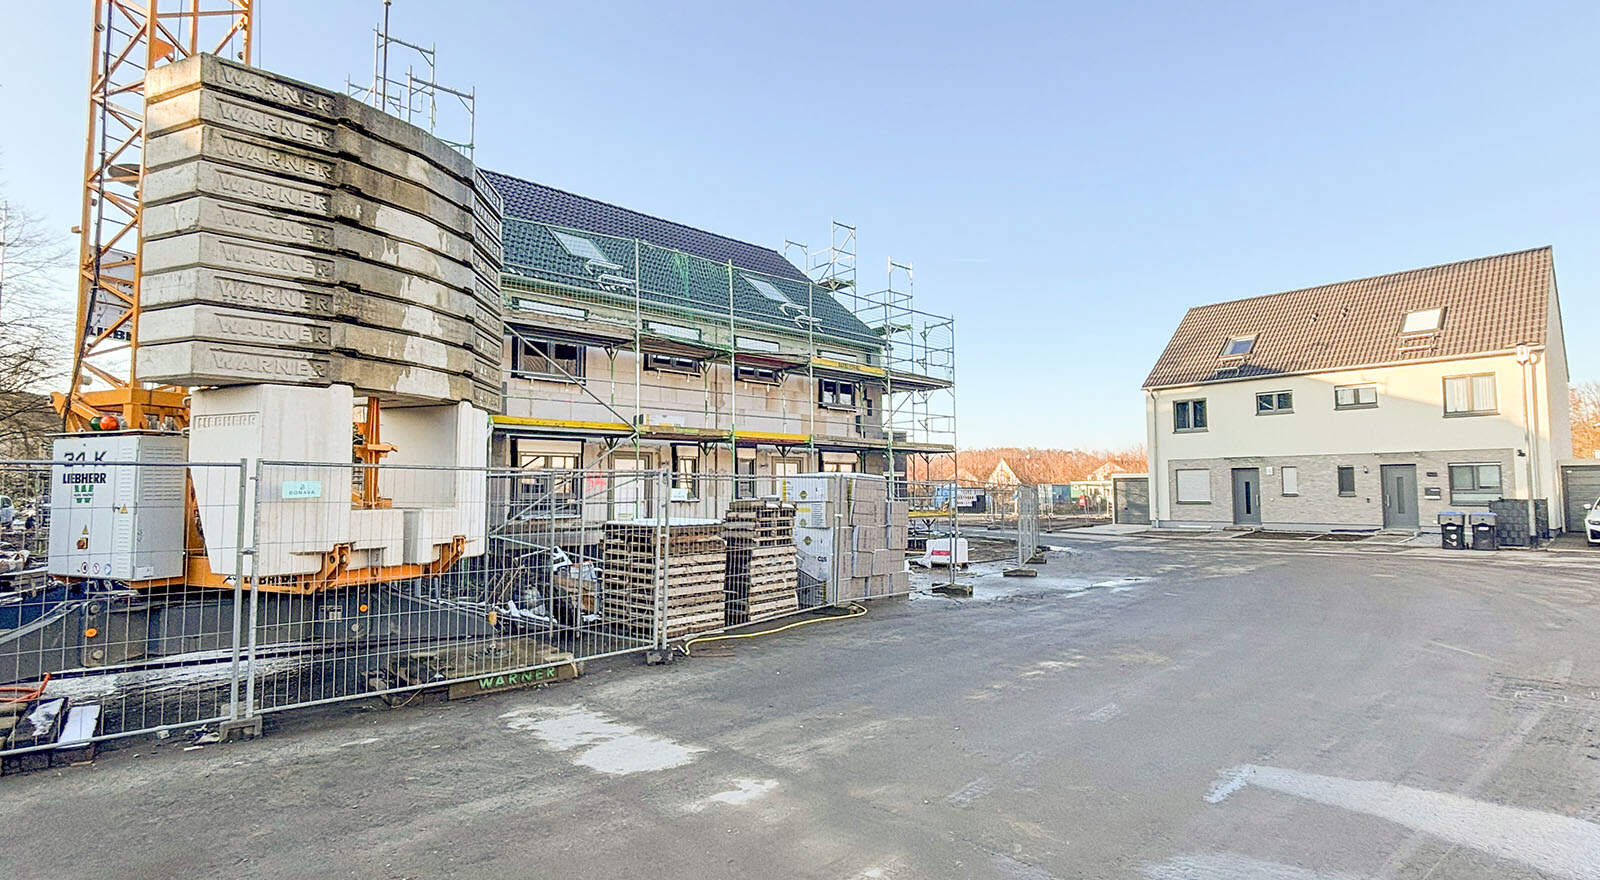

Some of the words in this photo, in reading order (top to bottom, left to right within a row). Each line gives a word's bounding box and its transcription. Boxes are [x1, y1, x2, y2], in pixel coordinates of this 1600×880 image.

[220, 64, 333, 113] WARNER
[218, 102, 331, 147] WARNER
[224, 139, 332, 178] WARNER
[218, 173, 328, 213] WARNER
[221, 209, 331, 244] WARNER
[221, 245, 331, 277] WARNER
[217, 279, 329, 312] WARNER
[217, 317, 327, 344] WARNER
[212, 352, 325, 377] WARNER
[95, 450, 108, 467] K
[62, 472, 107, 484] LIEBHERR
[479, 666, 555, 689] WARNER
